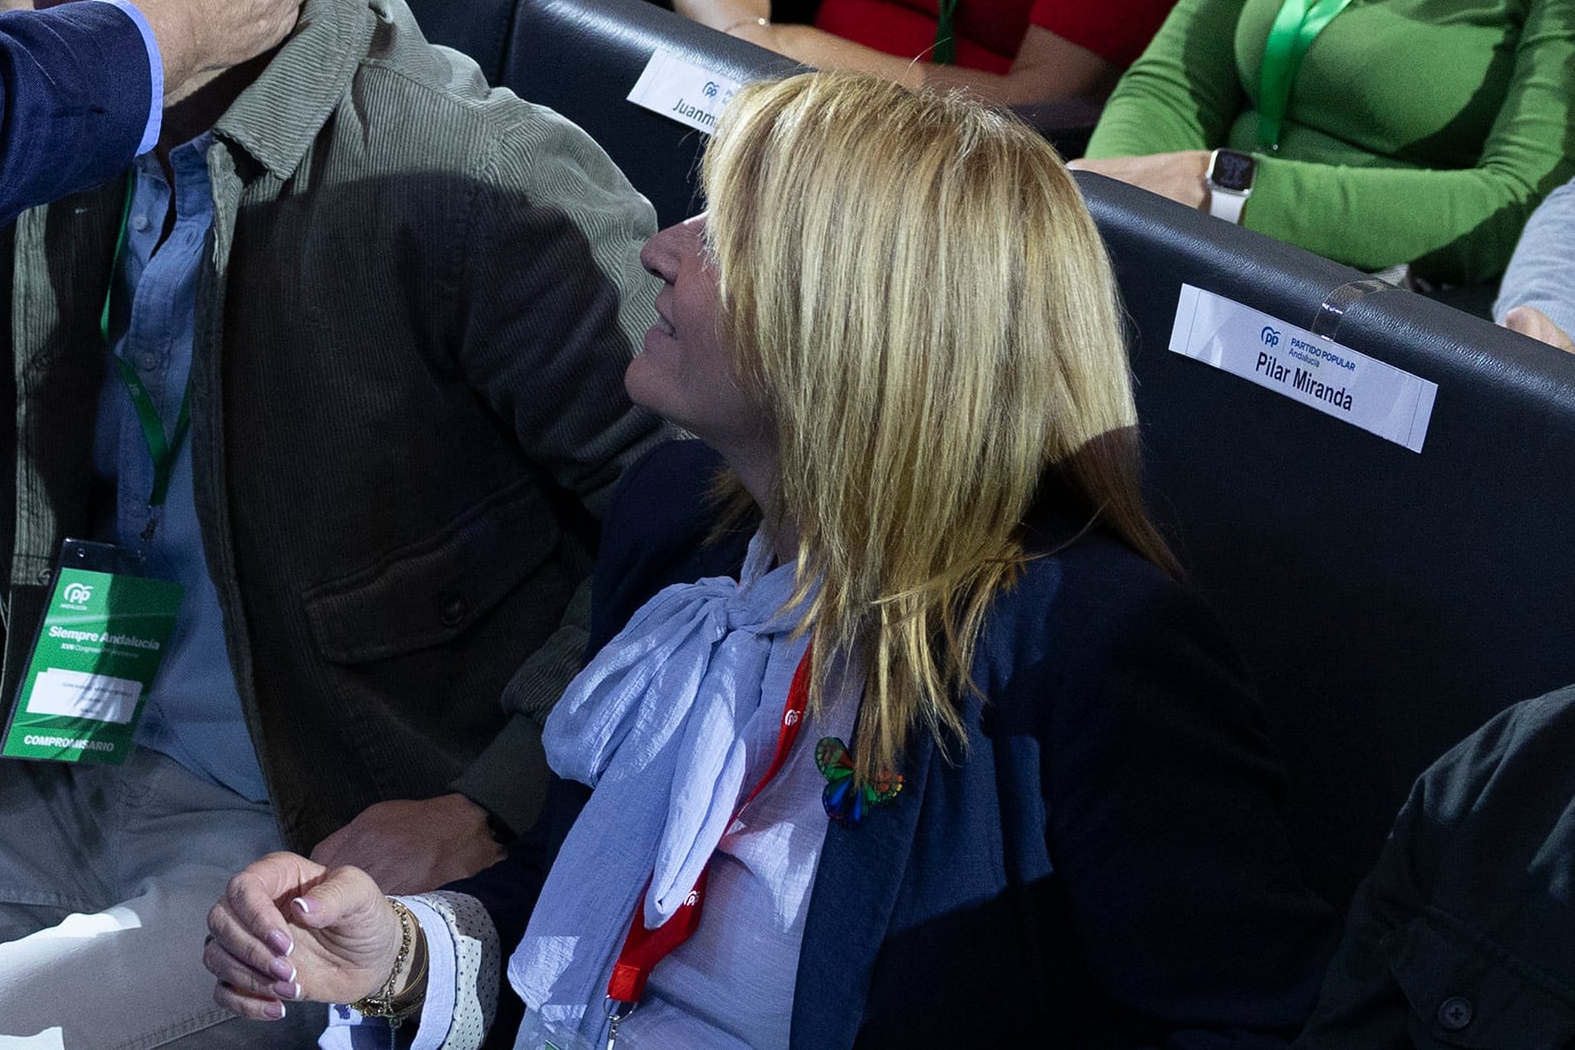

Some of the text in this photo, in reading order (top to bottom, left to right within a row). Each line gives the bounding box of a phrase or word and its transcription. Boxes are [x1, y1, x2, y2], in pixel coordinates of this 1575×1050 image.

[673, 98, 717, 126] Juanm
[1290, 338, 1356, 371] PARTIDO POPULAR
[1255, 351, 1353, 411] Pilar Miranda
[48, 625, 160, 651] Siempre Andalucía
[23, 734, 115, 752] COMPROMISARIO
